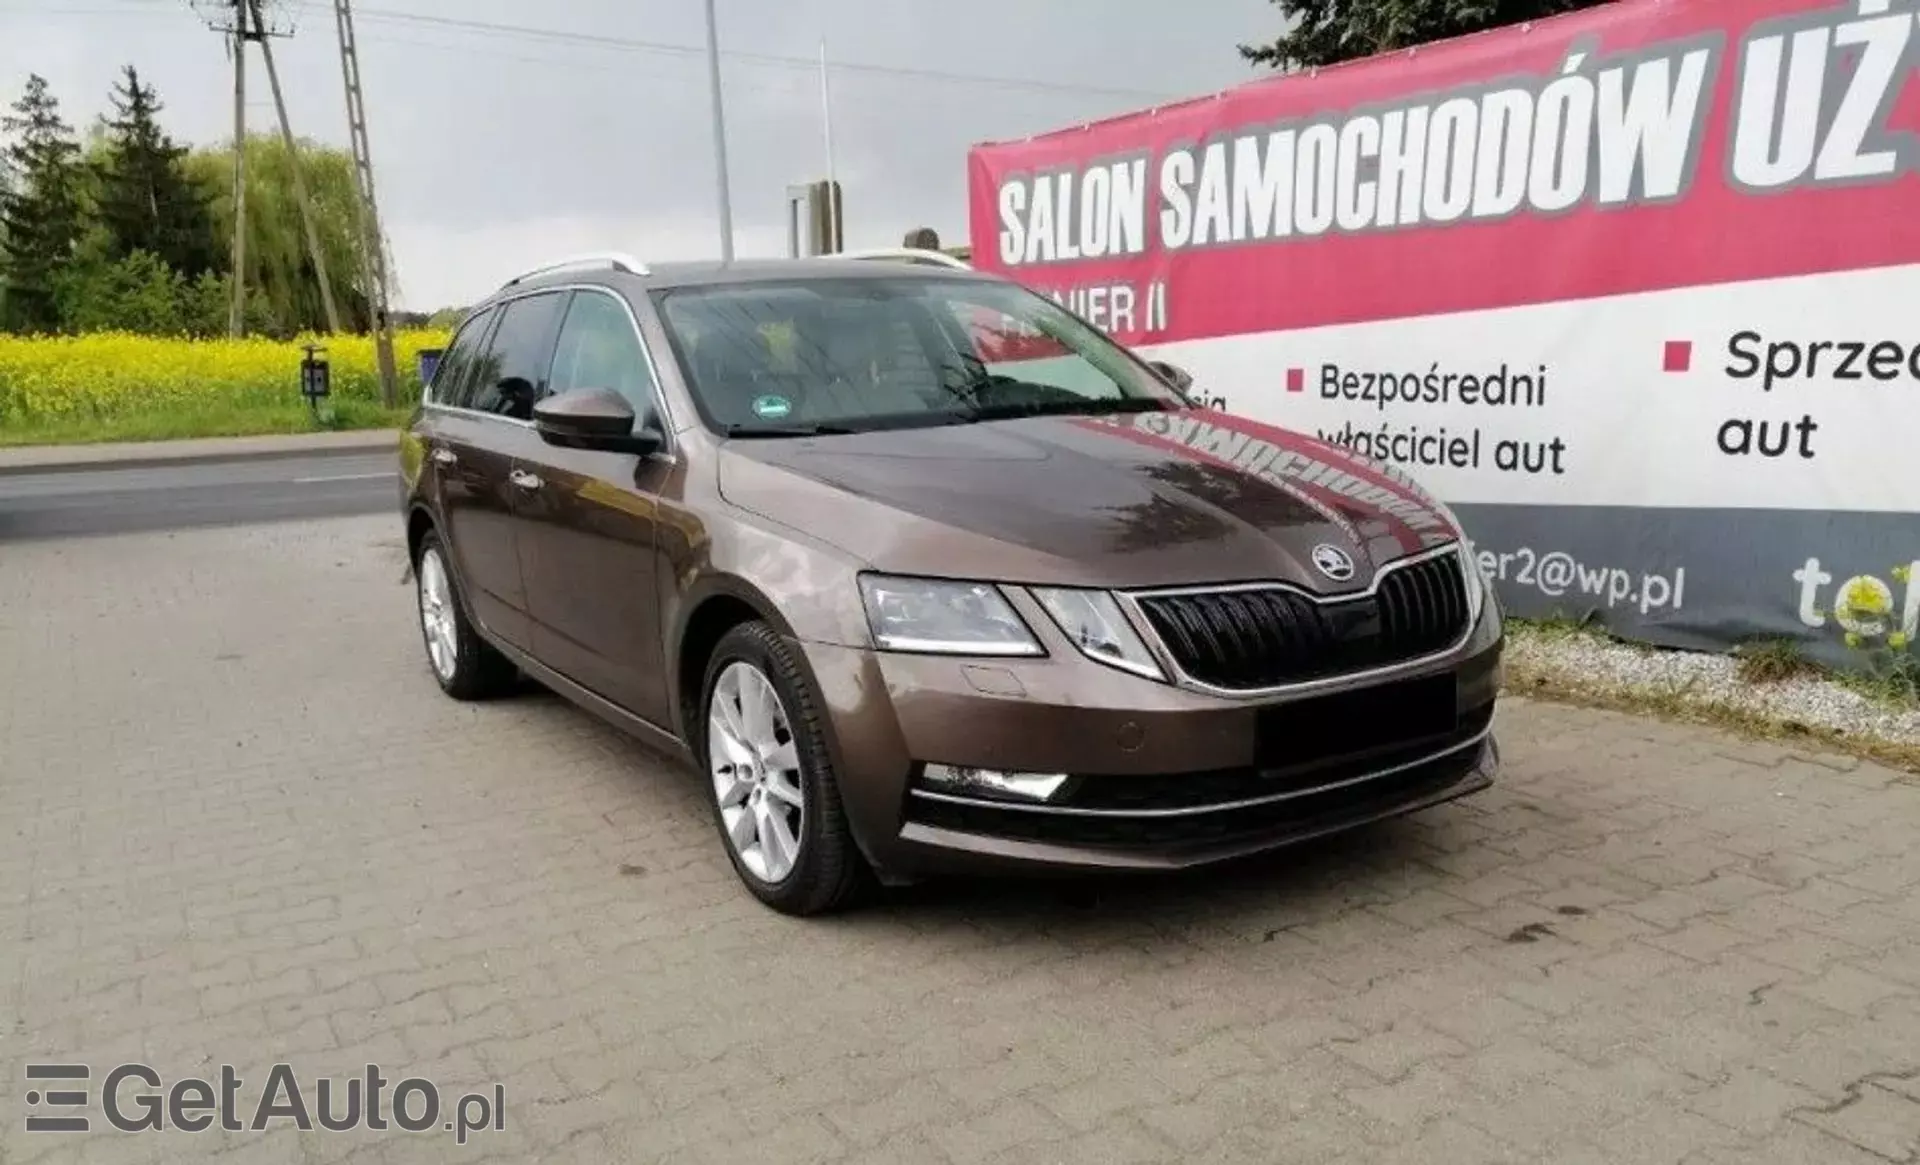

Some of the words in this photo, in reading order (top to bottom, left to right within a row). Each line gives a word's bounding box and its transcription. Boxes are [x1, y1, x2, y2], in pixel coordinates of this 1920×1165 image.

[999, 159, 1146, 265] SALON
[1160, 49, 1710, 249] SAMOCHODÓW
[1732, 0, 1920, 187] UŻ
[1320, 362, 1546, 410] Bezpośredni
[1725, 330, 1920, 391] Sprze
[1317, 421, 1480, 469] właściciel
[1494, 436, 1566, 474] aut
[1717, 414, 1818, 458] aut
[1468, 541, 1685, 615] er2@wp.pl
